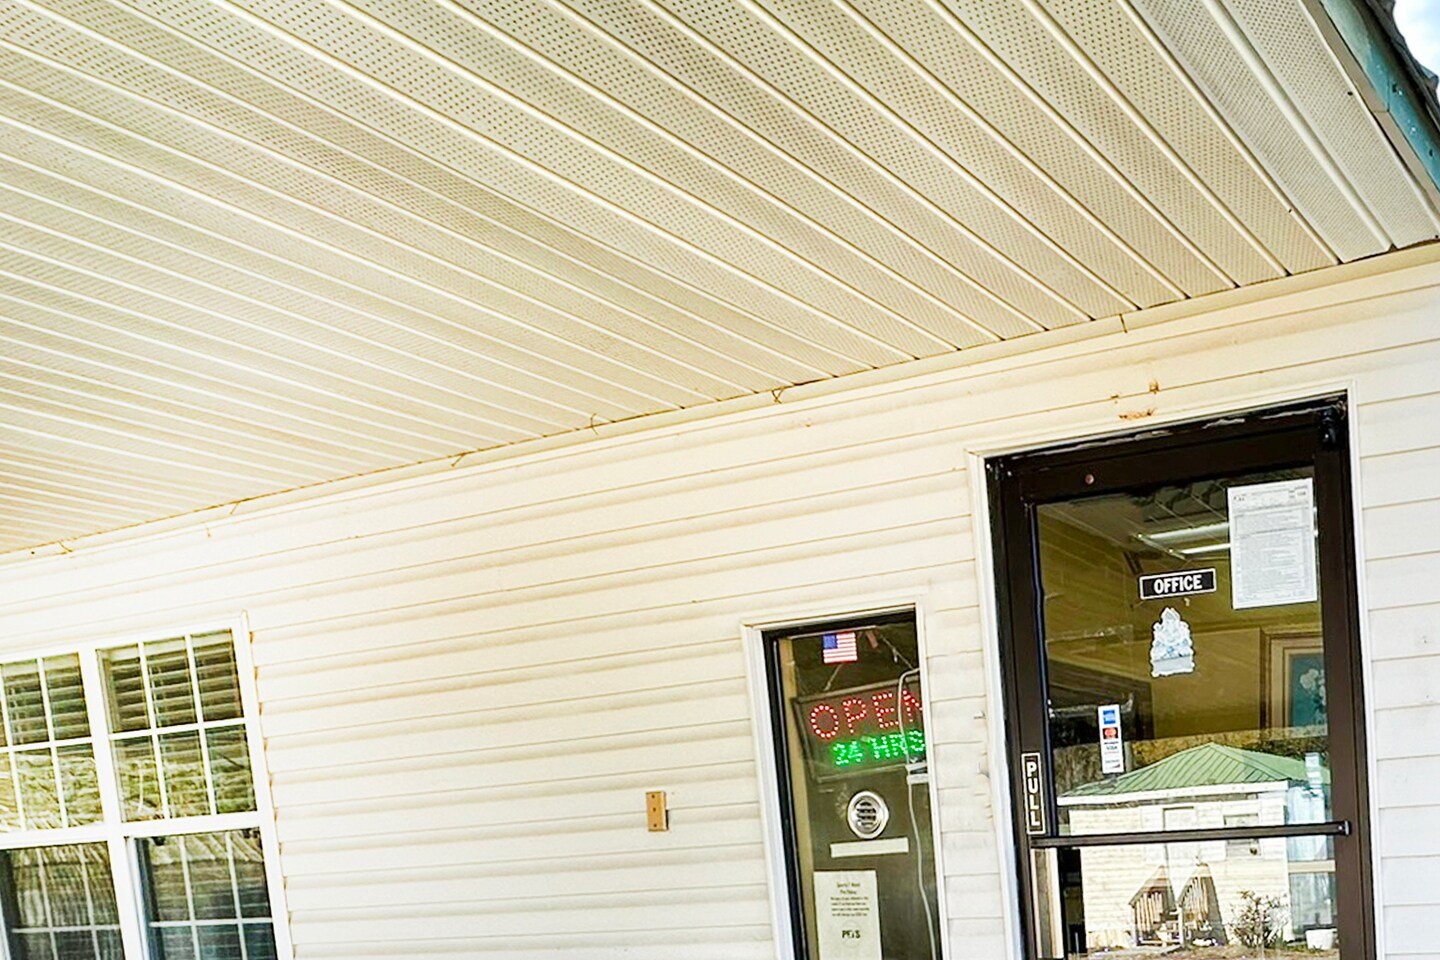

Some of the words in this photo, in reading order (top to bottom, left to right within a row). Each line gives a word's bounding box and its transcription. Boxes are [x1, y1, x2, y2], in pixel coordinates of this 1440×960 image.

[1153, 573, 1203, 595] OFFICE
[832, 741, 863, 766] 24
[869, 730, 925, 760] HRS
[1026, 761, 1041, 827] PULL
